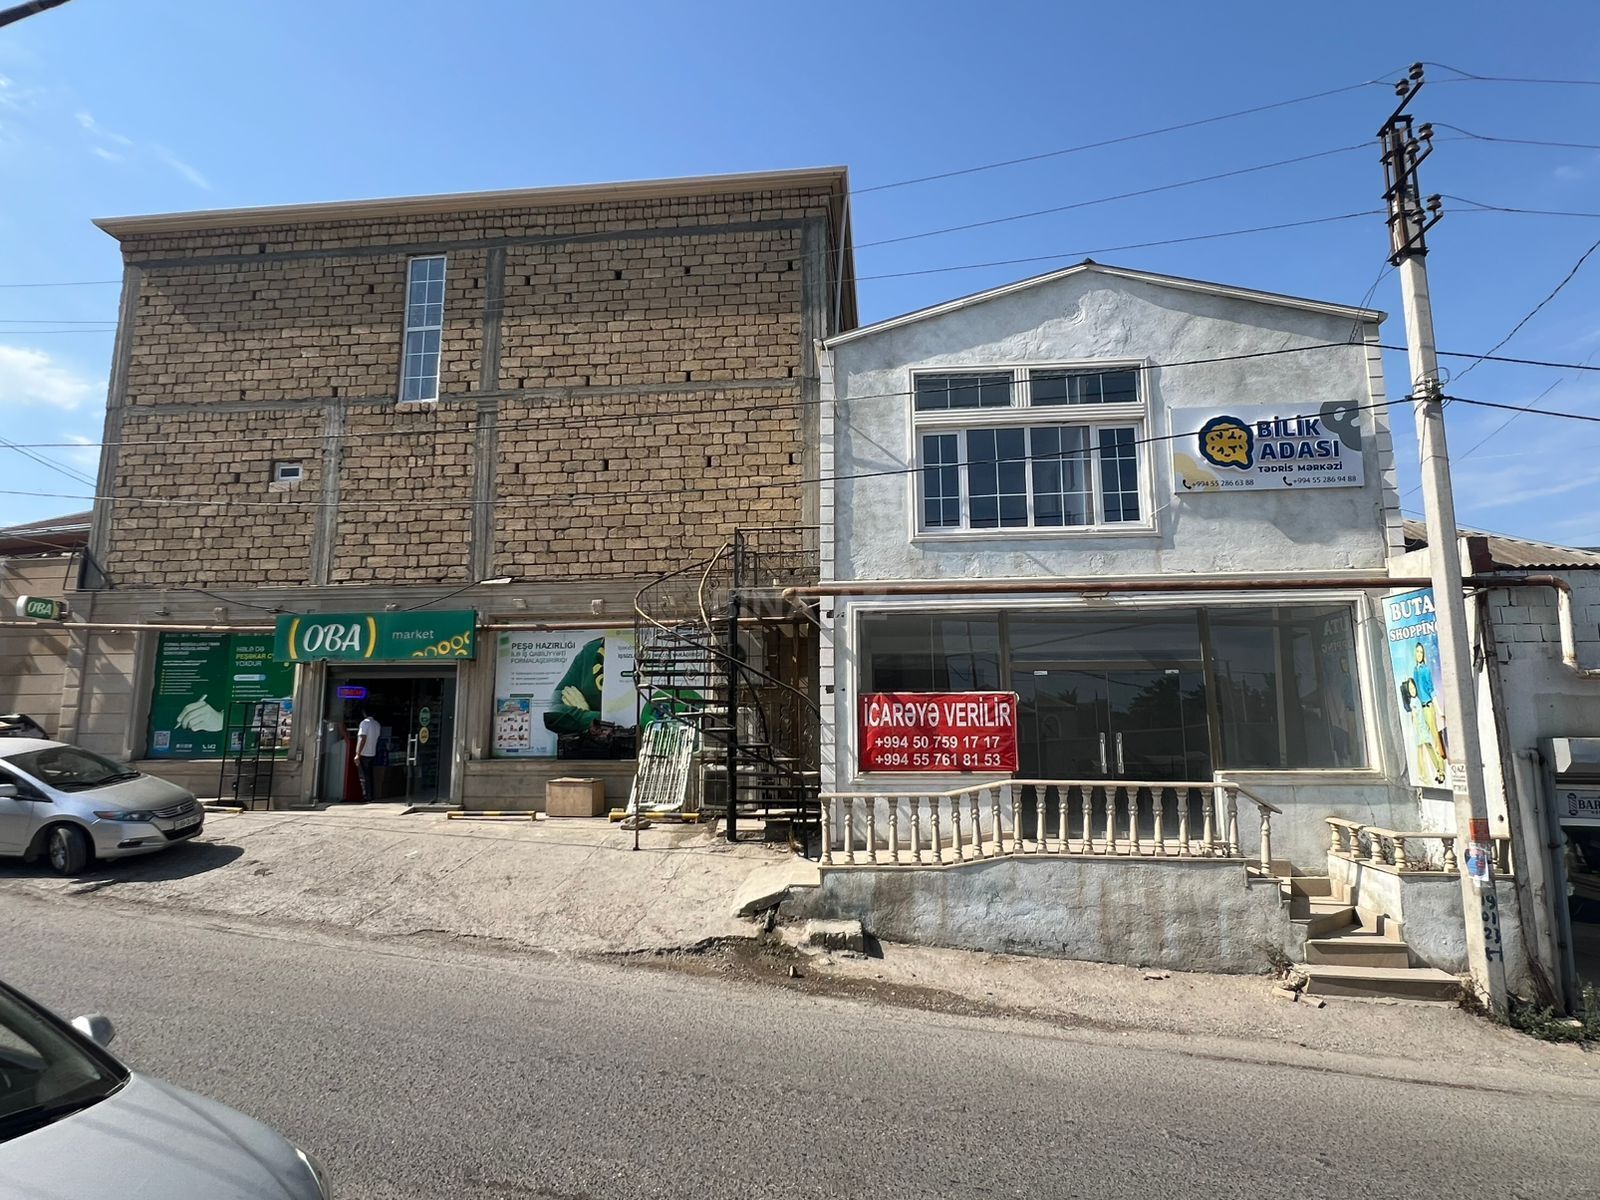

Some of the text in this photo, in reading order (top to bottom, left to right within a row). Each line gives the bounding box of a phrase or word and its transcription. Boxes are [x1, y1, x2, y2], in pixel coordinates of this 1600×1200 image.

[1256, 416, 1321, 438] BİLİK
[1260, 440, 1340, 460] ADASI
[1257, 461, 1343, 473] TƏDRİS MƏRKƏZİ
[1390, 595, 1436, 621] BUTA
[391, 629, 436, 640] market
[864, 697, 1012, 727] İCARƏYƏ VERİLİR
[875, 736, 1000, 748] +994 50 759 17 17
[875, 753, 1001, 766] +994 55 761 81 53
